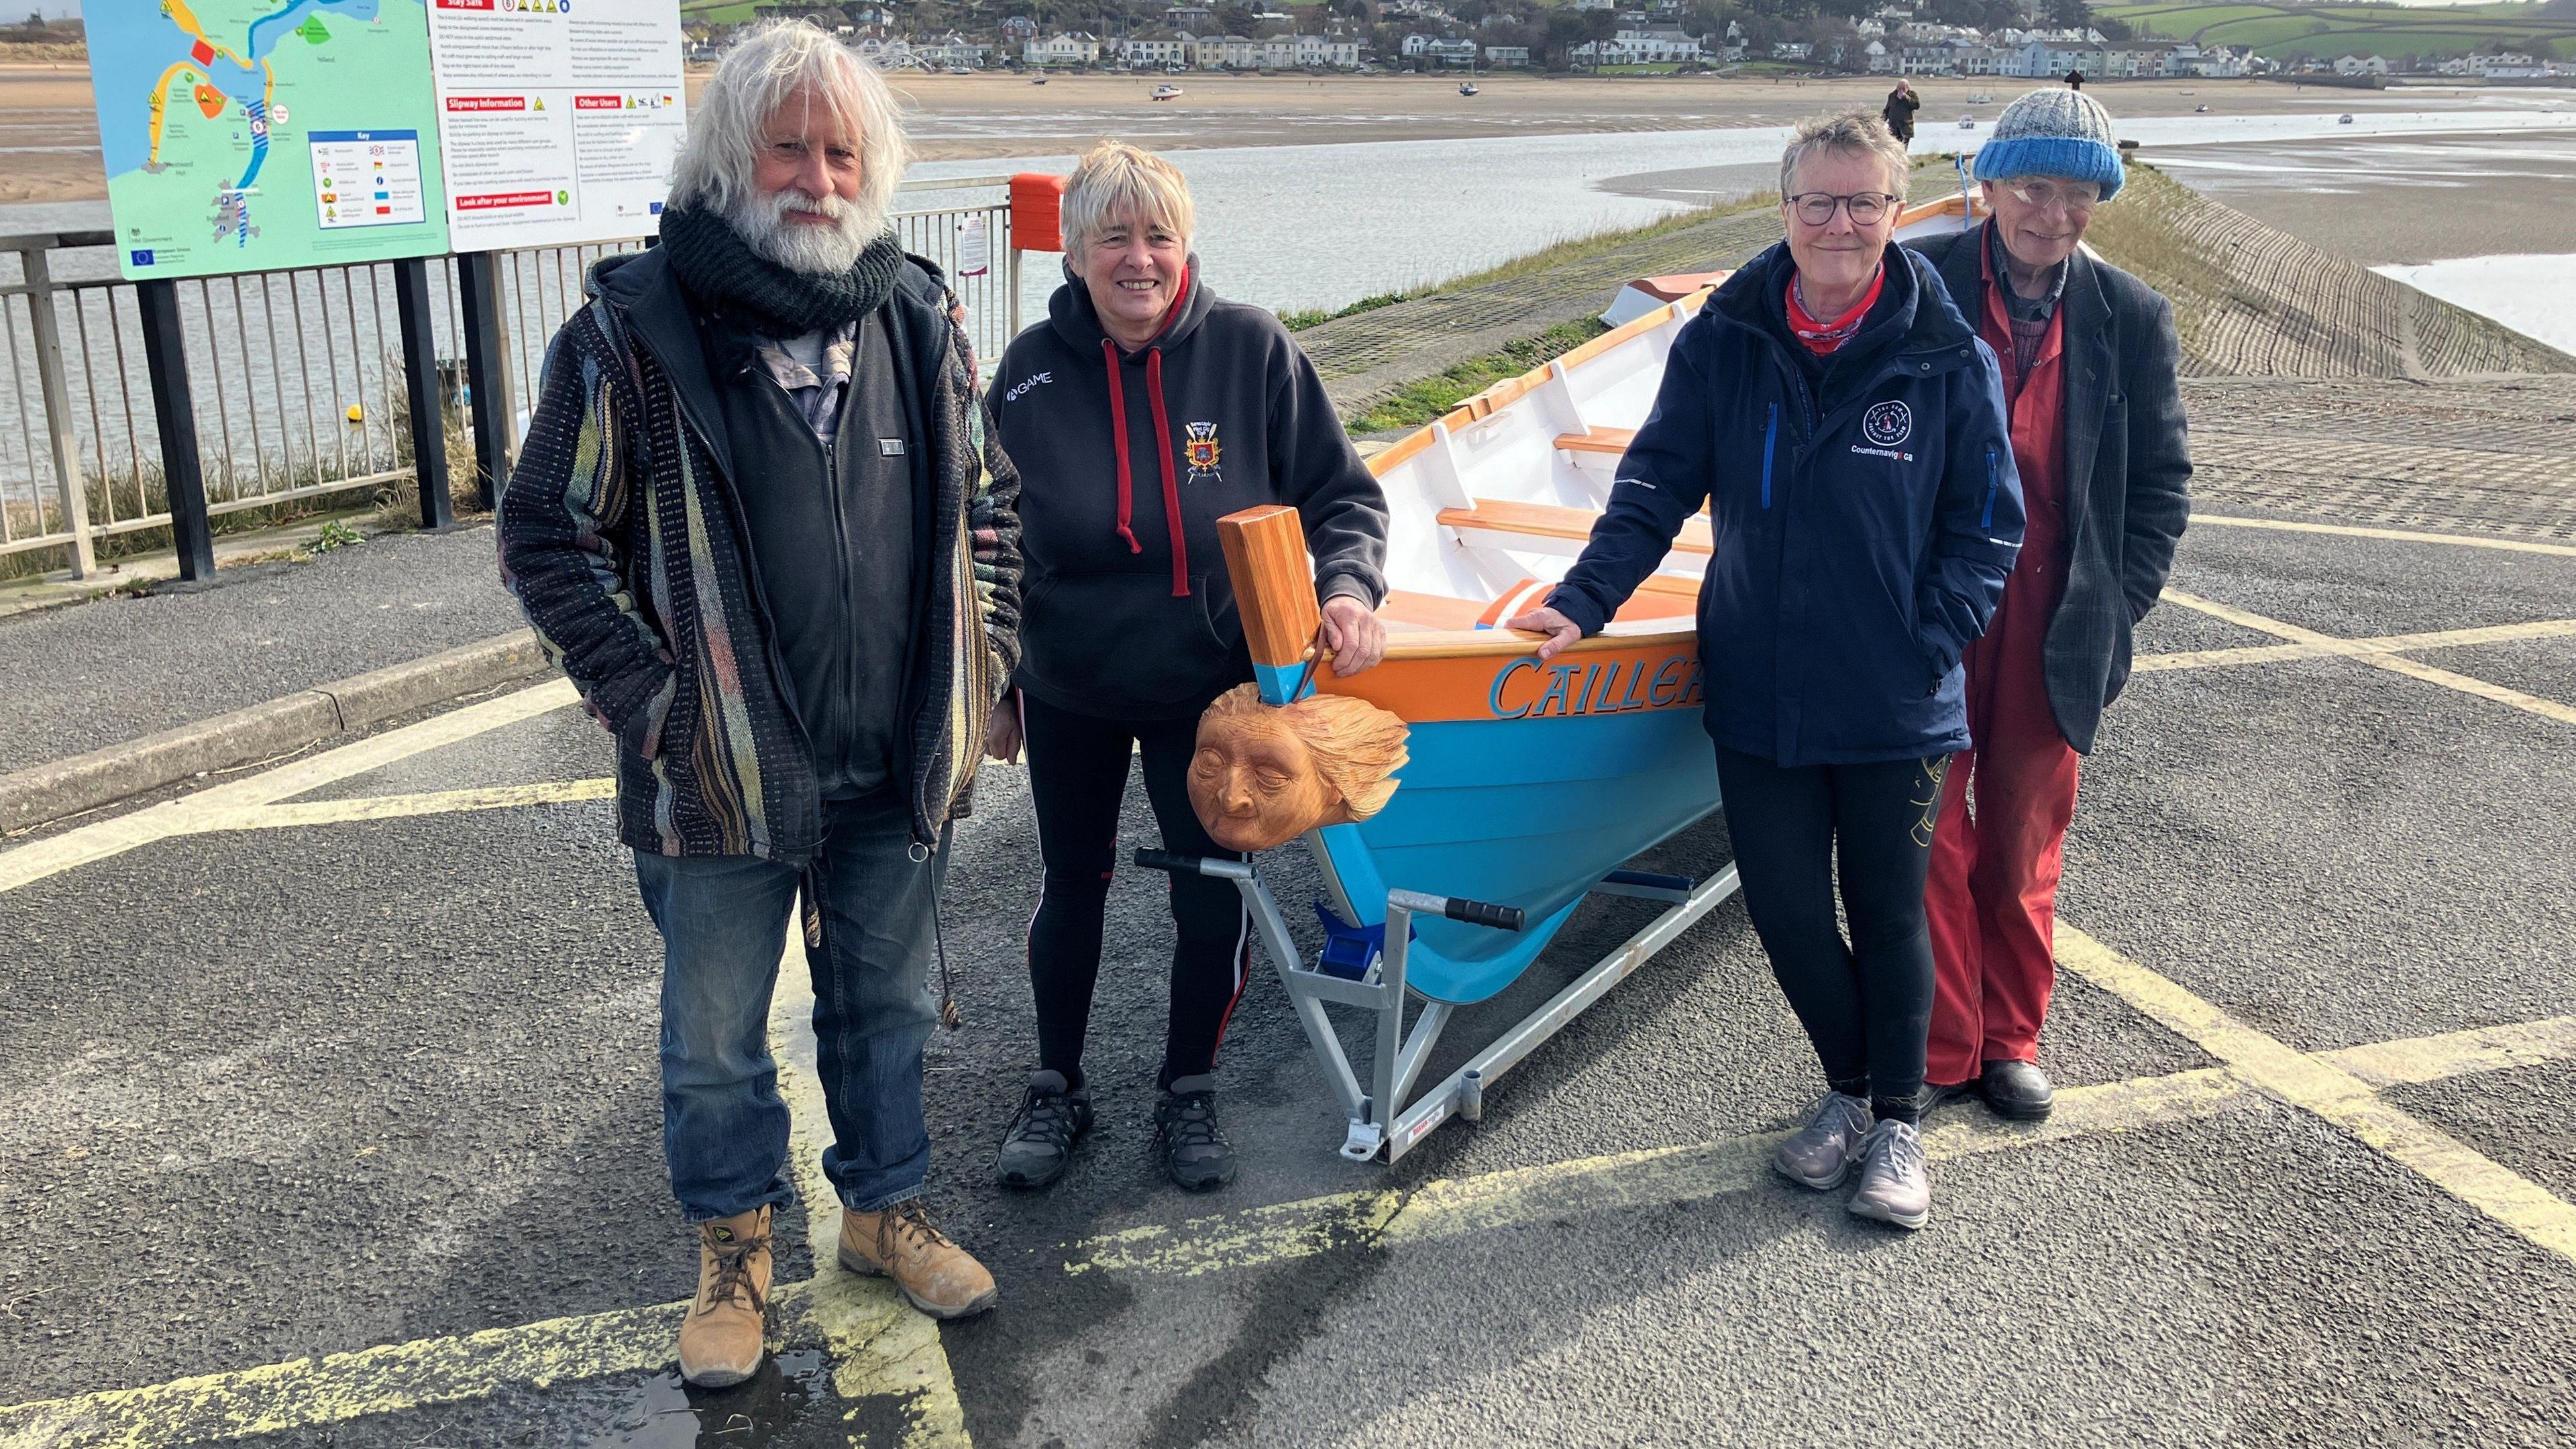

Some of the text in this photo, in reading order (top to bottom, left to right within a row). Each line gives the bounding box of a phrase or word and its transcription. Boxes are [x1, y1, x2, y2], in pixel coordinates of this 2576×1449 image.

[449, 99, 523, 109] Slipway Information
[579, 99, 618, 107] Other Users
[357, 132, 370, 140] Key
[460, 193, 549, 207] Look after your environment!
